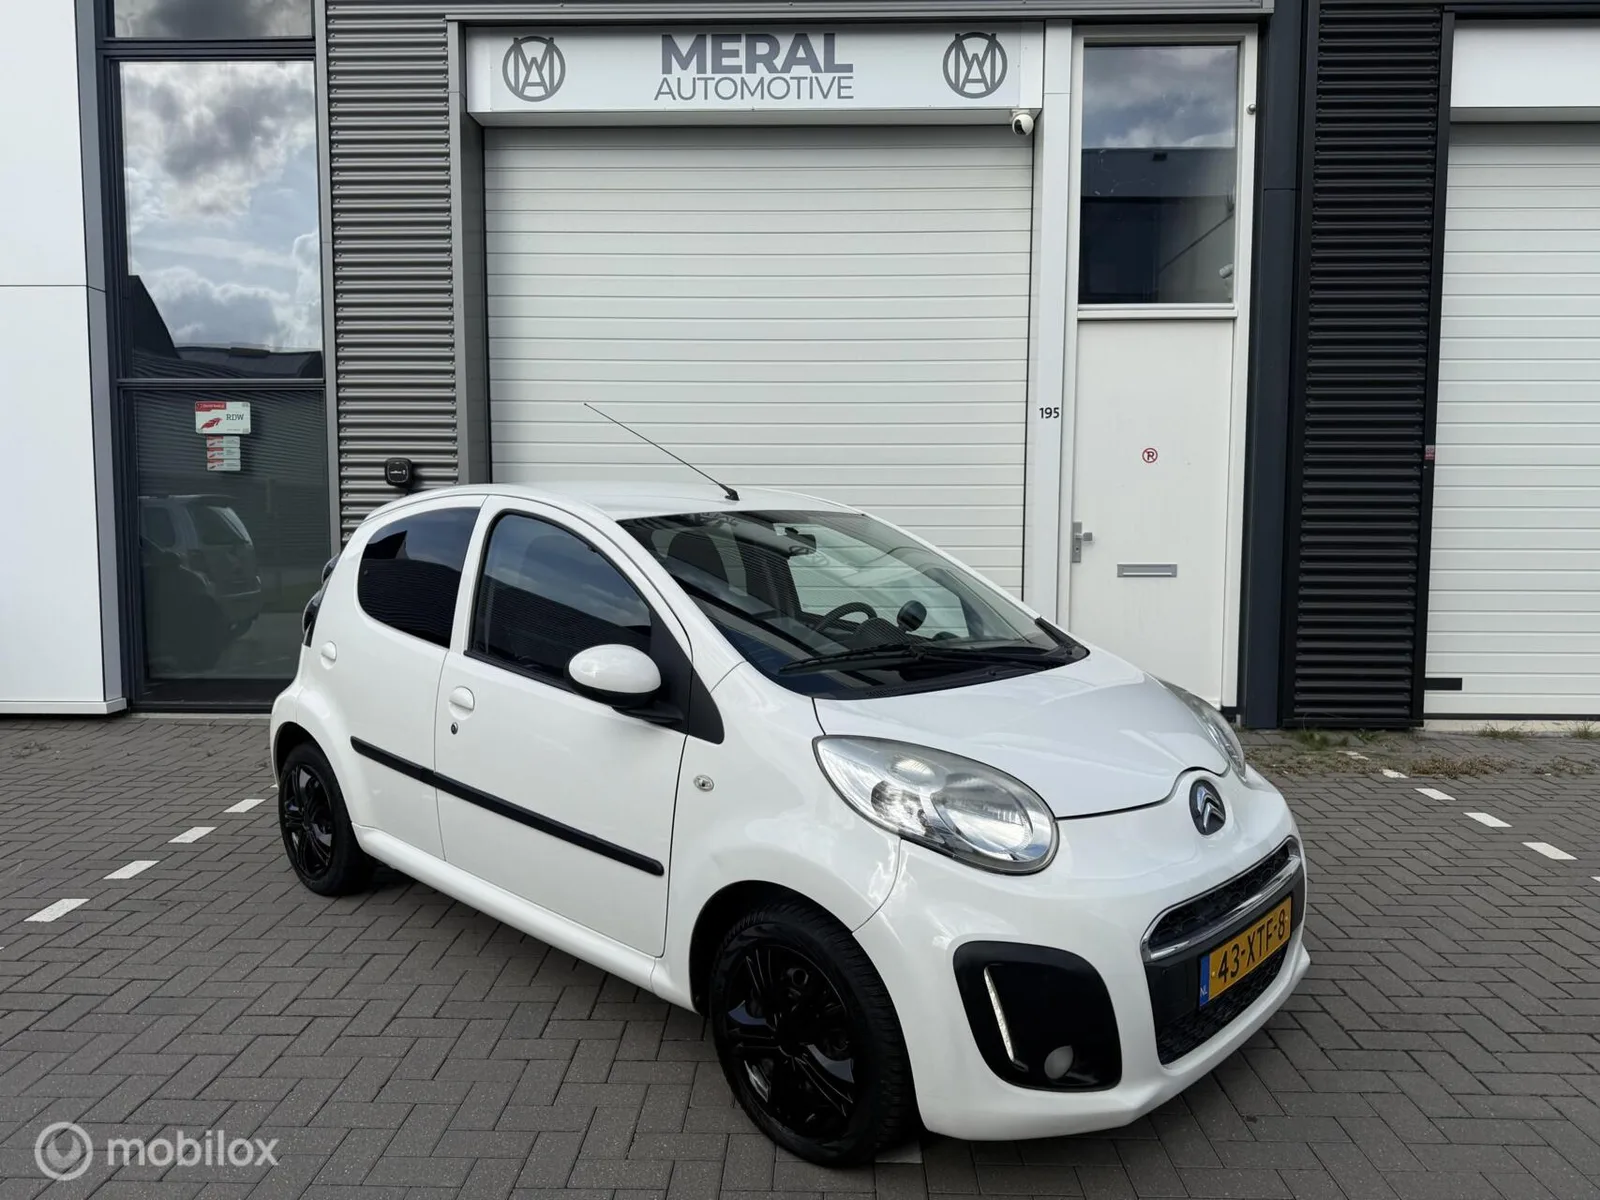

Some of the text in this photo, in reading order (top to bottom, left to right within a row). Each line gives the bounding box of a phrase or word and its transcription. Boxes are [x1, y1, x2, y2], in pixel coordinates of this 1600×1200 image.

[661, 33, 853, 74] MERAL
[654, 76, 854, 101] AUTOMOTIVE
[226, 413, 244, 421] RDW
[1039, 407, 1060, 419] 195
[1218, 908, 1286, 983] 43-XTF-8
[1200, 985, 1208, 997] NL
